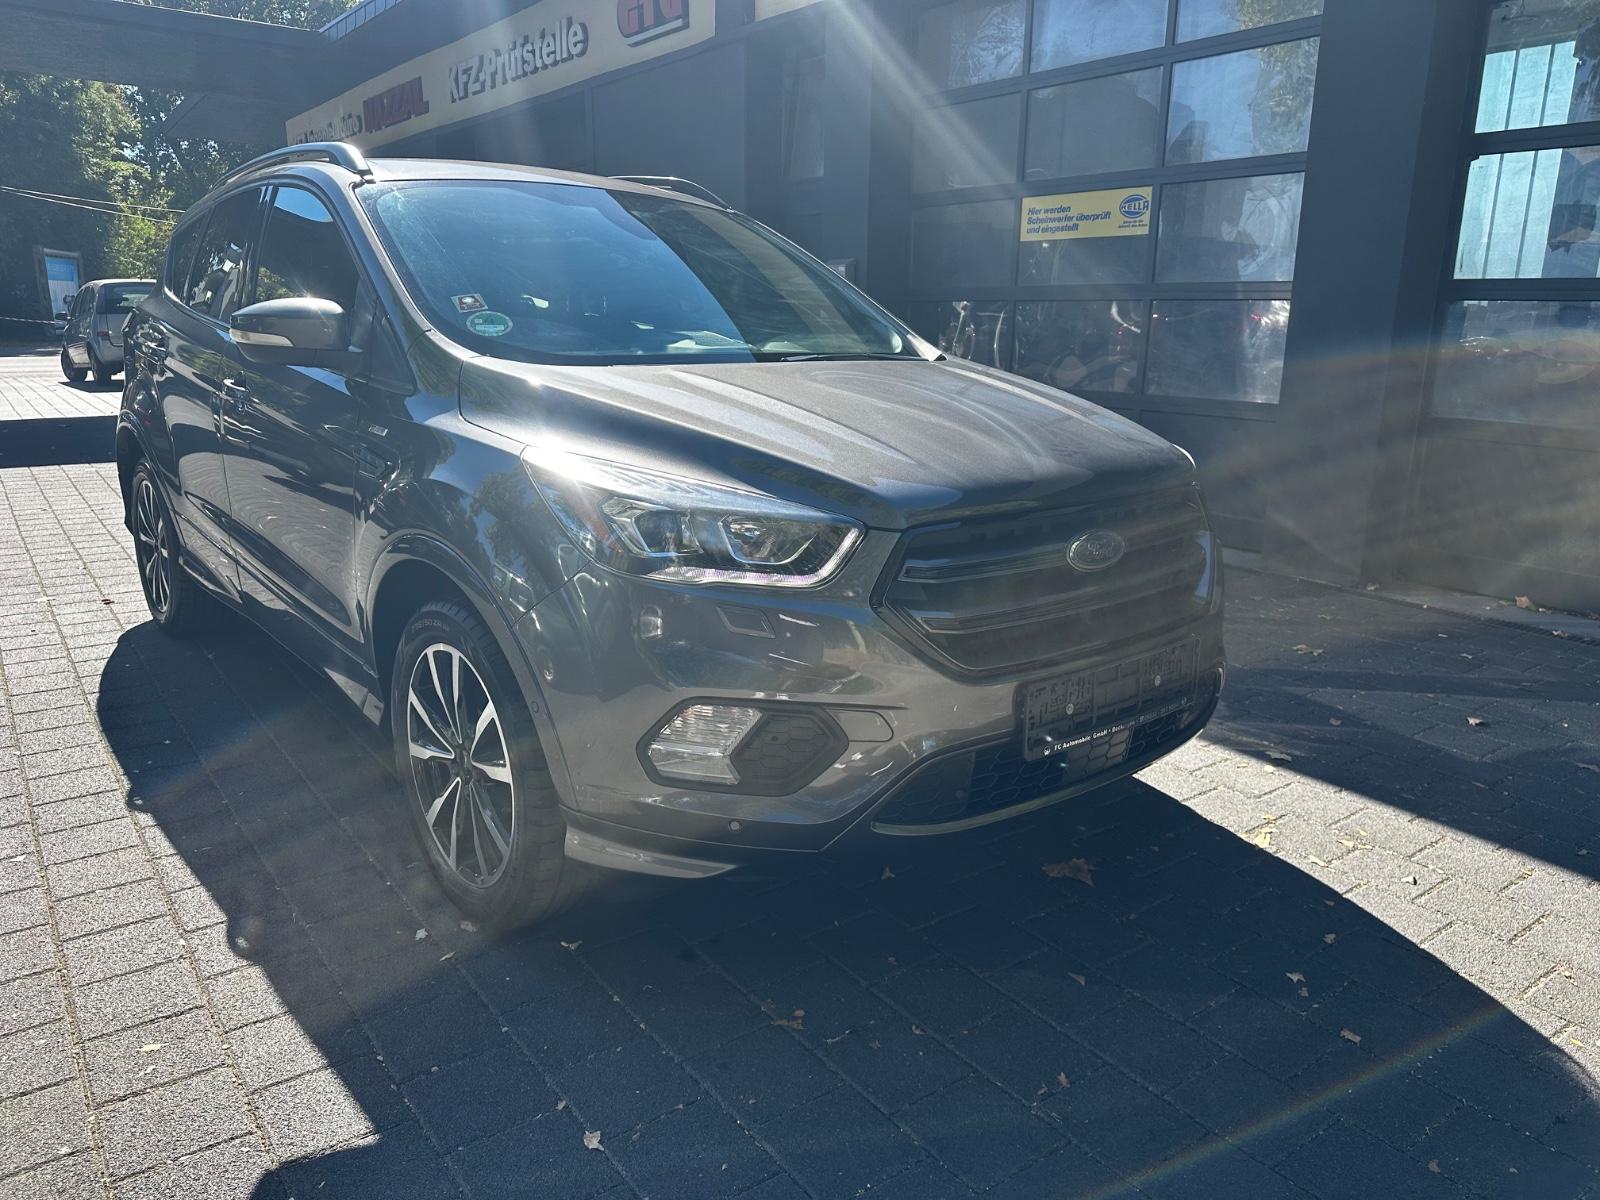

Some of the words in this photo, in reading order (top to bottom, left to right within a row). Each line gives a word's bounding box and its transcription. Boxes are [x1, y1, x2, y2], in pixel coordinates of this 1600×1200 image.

[1027, 207, 1042, 216] Hier
[1043, 205, 1071, 214] werden
[1121, 200, 1149, 212] HELLA
[1027, 214, 1074, 225] Scheinwerfer
[1076, 211, 1111, 223] überprüft
[1026, 225, 1040, 234] und
[1041, 223, 1079, 234] eingestellt
[1092, 729, 1108, 739] GmbH
